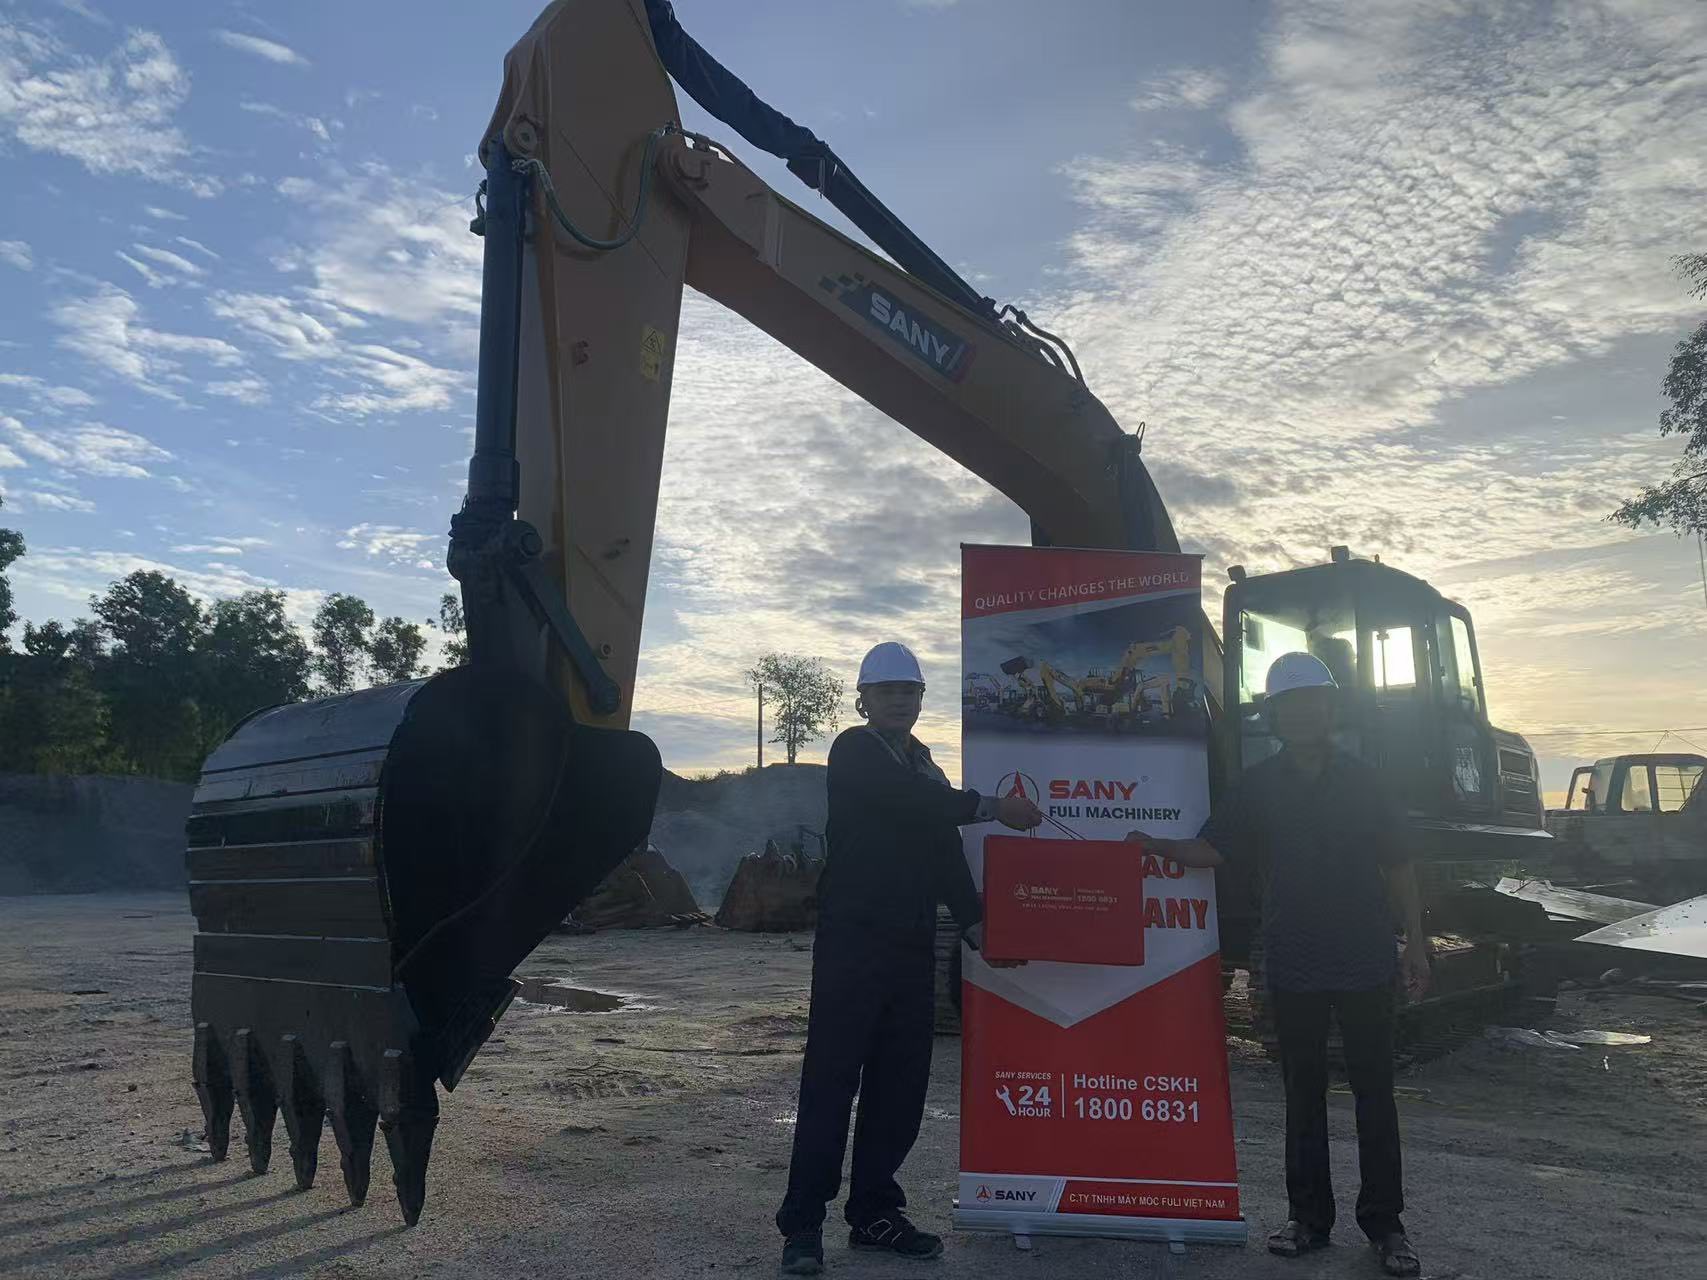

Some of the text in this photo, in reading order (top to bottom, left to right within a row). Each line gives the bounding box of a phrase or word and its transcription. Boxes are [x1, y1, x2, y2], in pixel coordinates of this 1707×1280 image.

[870, 291, 950, 365] SANY
[975, 571, 1189, 610] QUALITY CHANGES THE WORLD
[1049, 779, 1138, 801] SANY
[1049, 805, 1181, 821] FULI MACHINERY
[1143, 897, 1209, 930] ANY
[994, 1071, 1051, 1080] SANY SERVICES
[1073, 1073, 1199, 1093] Hotline CSKH
[1018, 1085, 1051, 1106] 24
[1018, 1107, 1051, 1118] HOUR
[1073, 1096, 1199, 1123] 1800 6831
[994, 1189, 1037, 1201] SANY
[1091, 1194, 1116, 1204] TNHH
[1161, 1196, 1181, 1207] FULI
[1205, 1199, 1226, 1209] NAM
